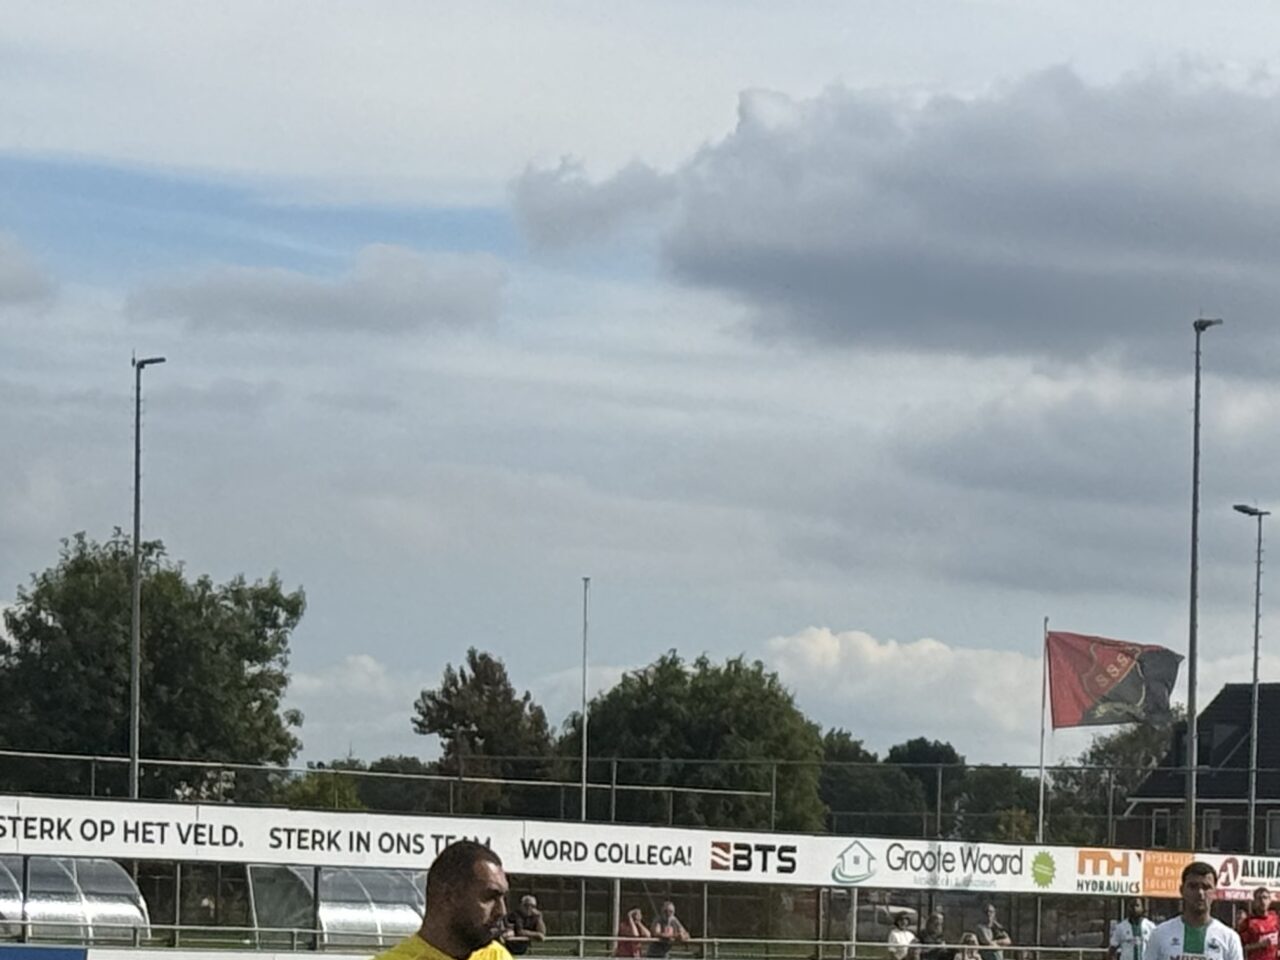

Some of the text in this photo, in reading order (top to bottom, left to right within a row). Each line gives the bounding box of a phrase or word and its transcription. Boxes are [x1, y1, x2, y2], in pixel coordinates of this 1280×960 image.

[80, 819, 115, 842] OP
[124, 821, 169, 844] HET
[176, 823, 244, 848] VELD.
[269, 828, 341, 851] STERK
[349, 831, 371, 851] IN
[378, 833, 425, 854] ONS
[521, 838, 692, 866] WORD COLLEGA!
[733, 843, 797, 873] BTS
[886, 843, 1023, 876] Groote Waard
[1076, 880, 1140, 894] HYDRAULICS
